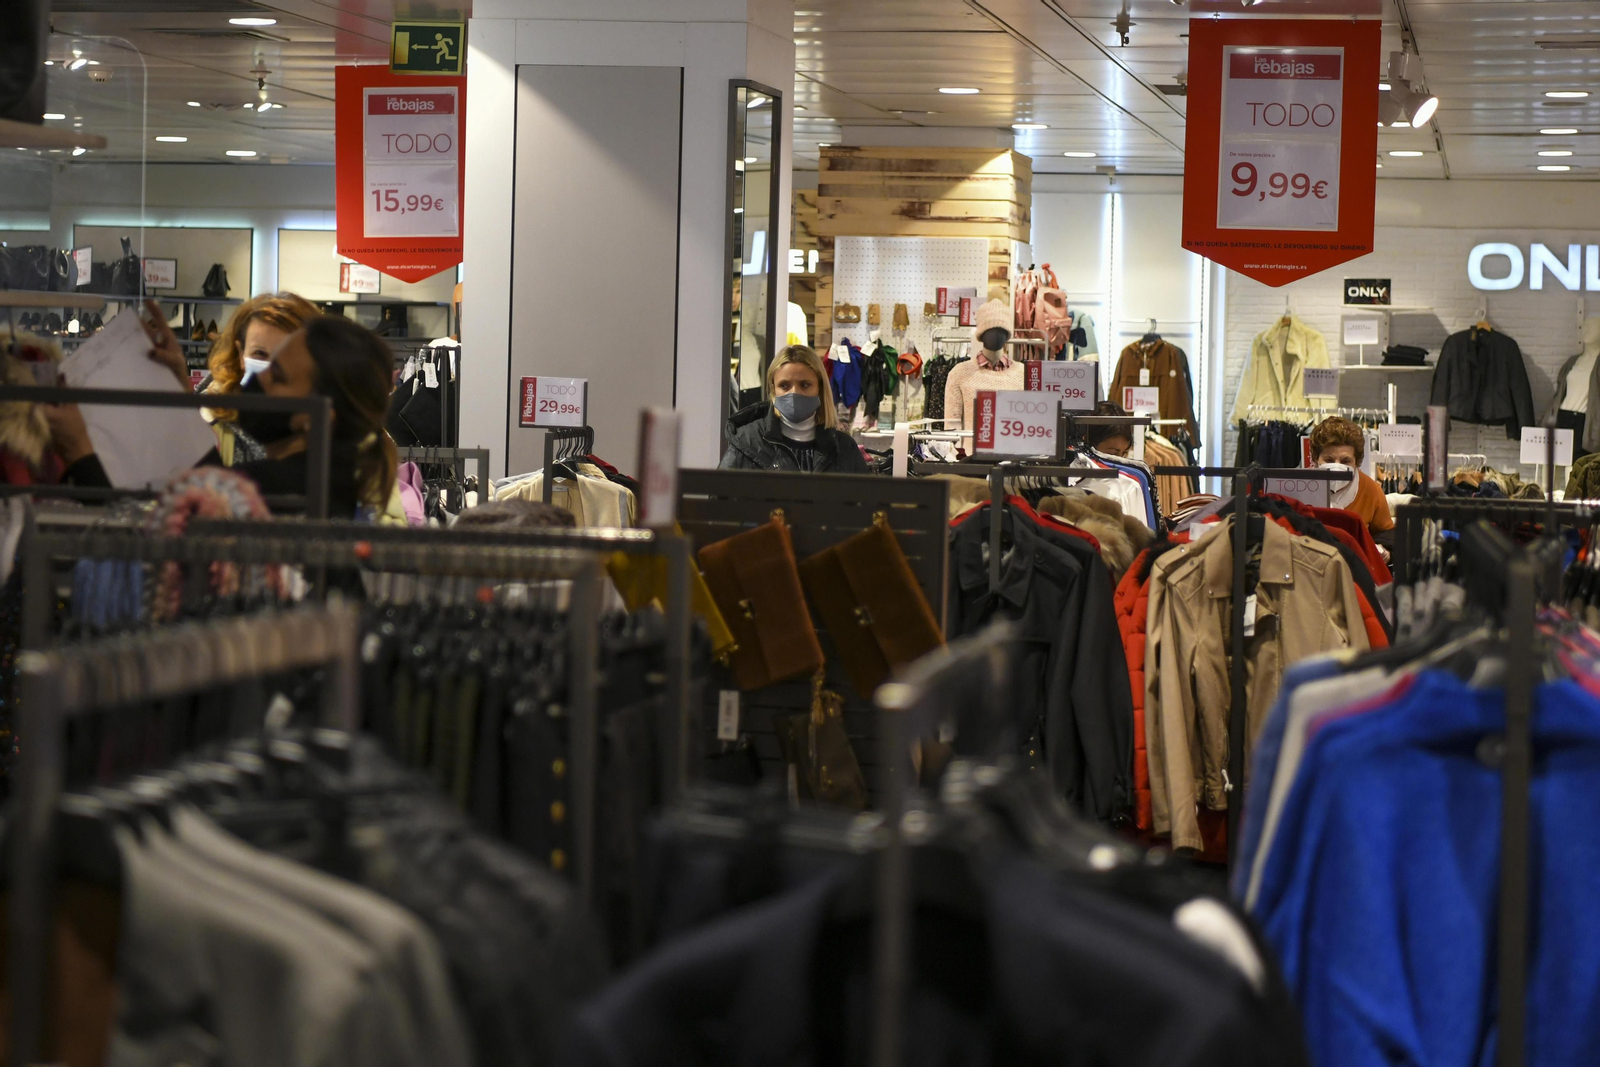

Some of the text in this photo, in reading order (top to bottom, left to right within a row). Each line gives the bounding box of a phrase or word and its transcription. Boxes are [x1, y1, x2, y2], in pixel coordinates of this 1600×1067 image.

[1254, 60, 1315, 77] rebajas
[386, 98, 435, 113] rebajas
[1246, 102, 1335, 128] TODO
[381, 133, 452, 153] TODO
[1231, 161, 1329, 202] 9,99€
[371, 189, 444, 215] 15,99€
[1347, 286, 1387, 298] ONLY
[1051, 368, 1086, 378] TODO
[545, 384, 577, 396] TODO
[524, 383, 535, 418] rebajas
[539, 400, 581, 414] 29,99€
[1007, 400, 1048, 414] TODO
[980, 398, 994, 442] rebajas
[1000, 420, 1053, 438] 39,99€
[1276, 480, 1320, 493] TODO
